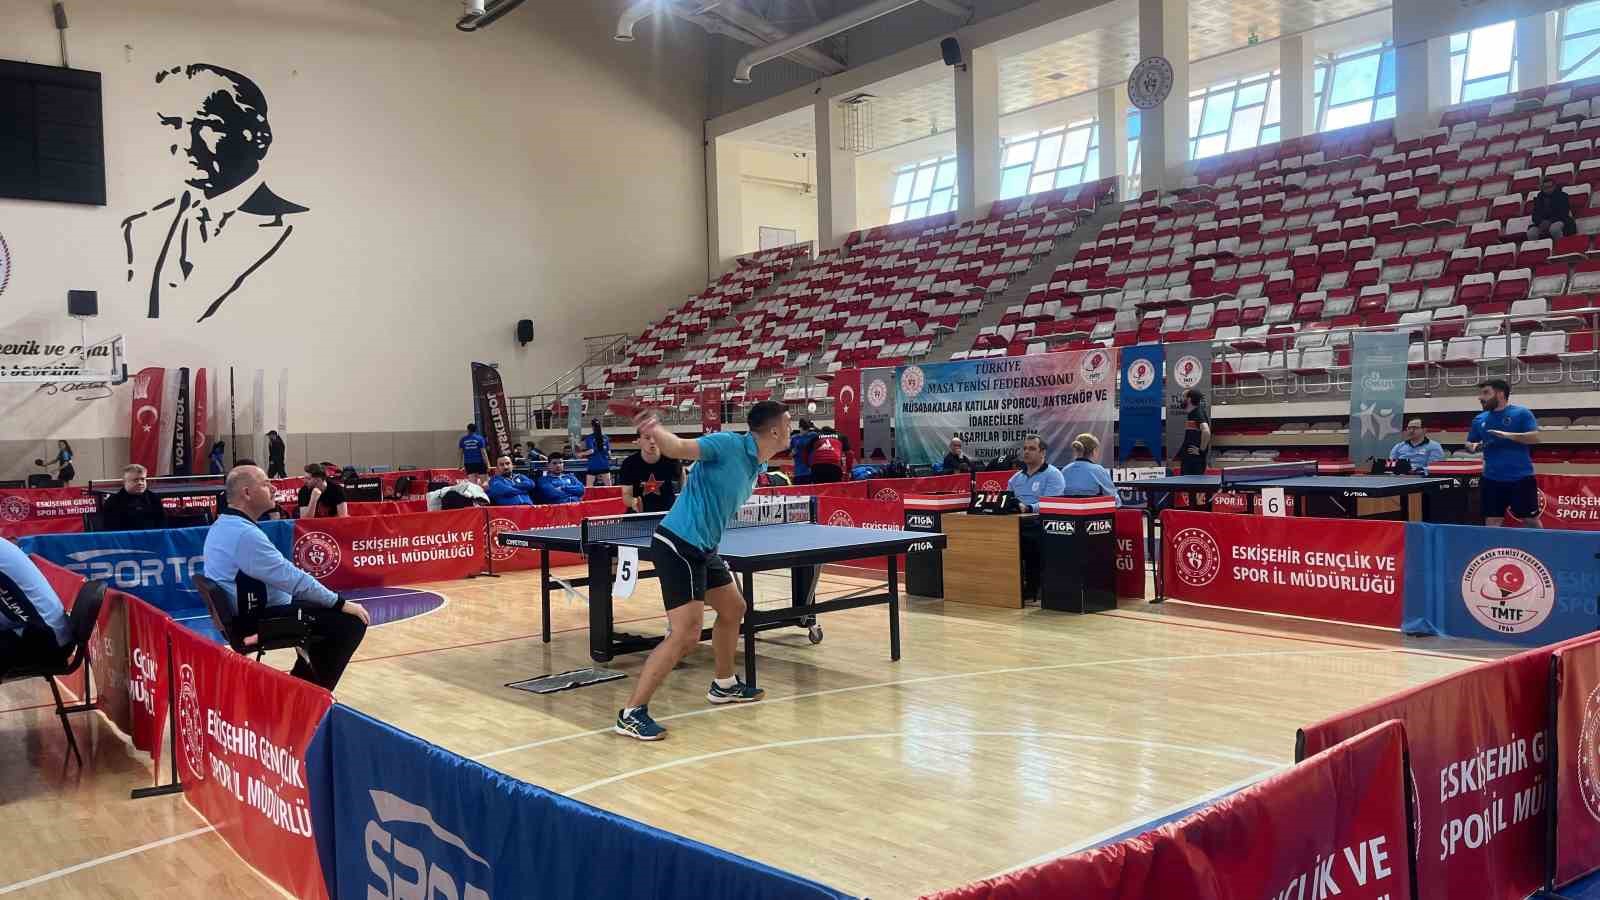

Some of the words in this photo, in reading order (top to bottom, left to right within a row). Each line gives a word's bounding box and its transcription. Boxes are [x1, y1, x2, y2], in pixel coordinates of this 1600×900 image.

[44, 344, 65, 356] ve
[927, 381, 955, 393] MASA
[993, 373, 1074, 390] FEDERASYONU
[1095, 389, 1108, 401] VE
[975, 493, 985, 508] 2
[1000, 494, 1008, 509] 1
[1268, 497, 1279, 513] 6
[1555, 508, 1587, 519] SPOR
[351, 536, 409, 551] ESKİŞEHİR
[412, 531, 458, 546] GENÇLİK
[460, 531, 475, 541] VE
[1117, 539, 1133, 551] VE
[352, 554, 385, 568] SPOR
[387, 551, 399, 565] İL
[401, 543, 475, 564] MÜDÜRLÜĞÜ
[1232, 544, 1301, 566] ESKİŞEHİR
[1304, 551, 1371, 572] GENÇLİK
[1375, 555, 1396, 572] VE
[621, 560, 631, 581] 5
[1233, 566, 1269, 584] SPOR
[1272, 566, 1287, 585] İL
[1290, 569, 1396, 595] MÜDÜRLÜĞÜ
[1490, 606, 1525, 621] TMTF
[1440, 732, 1529, 804] ESKİŞEHİR
[1440, 808, 1492, 861] SPOR
[1492, 791, 1508, 835] İL
[1344, 835, 1392, 886] VE
